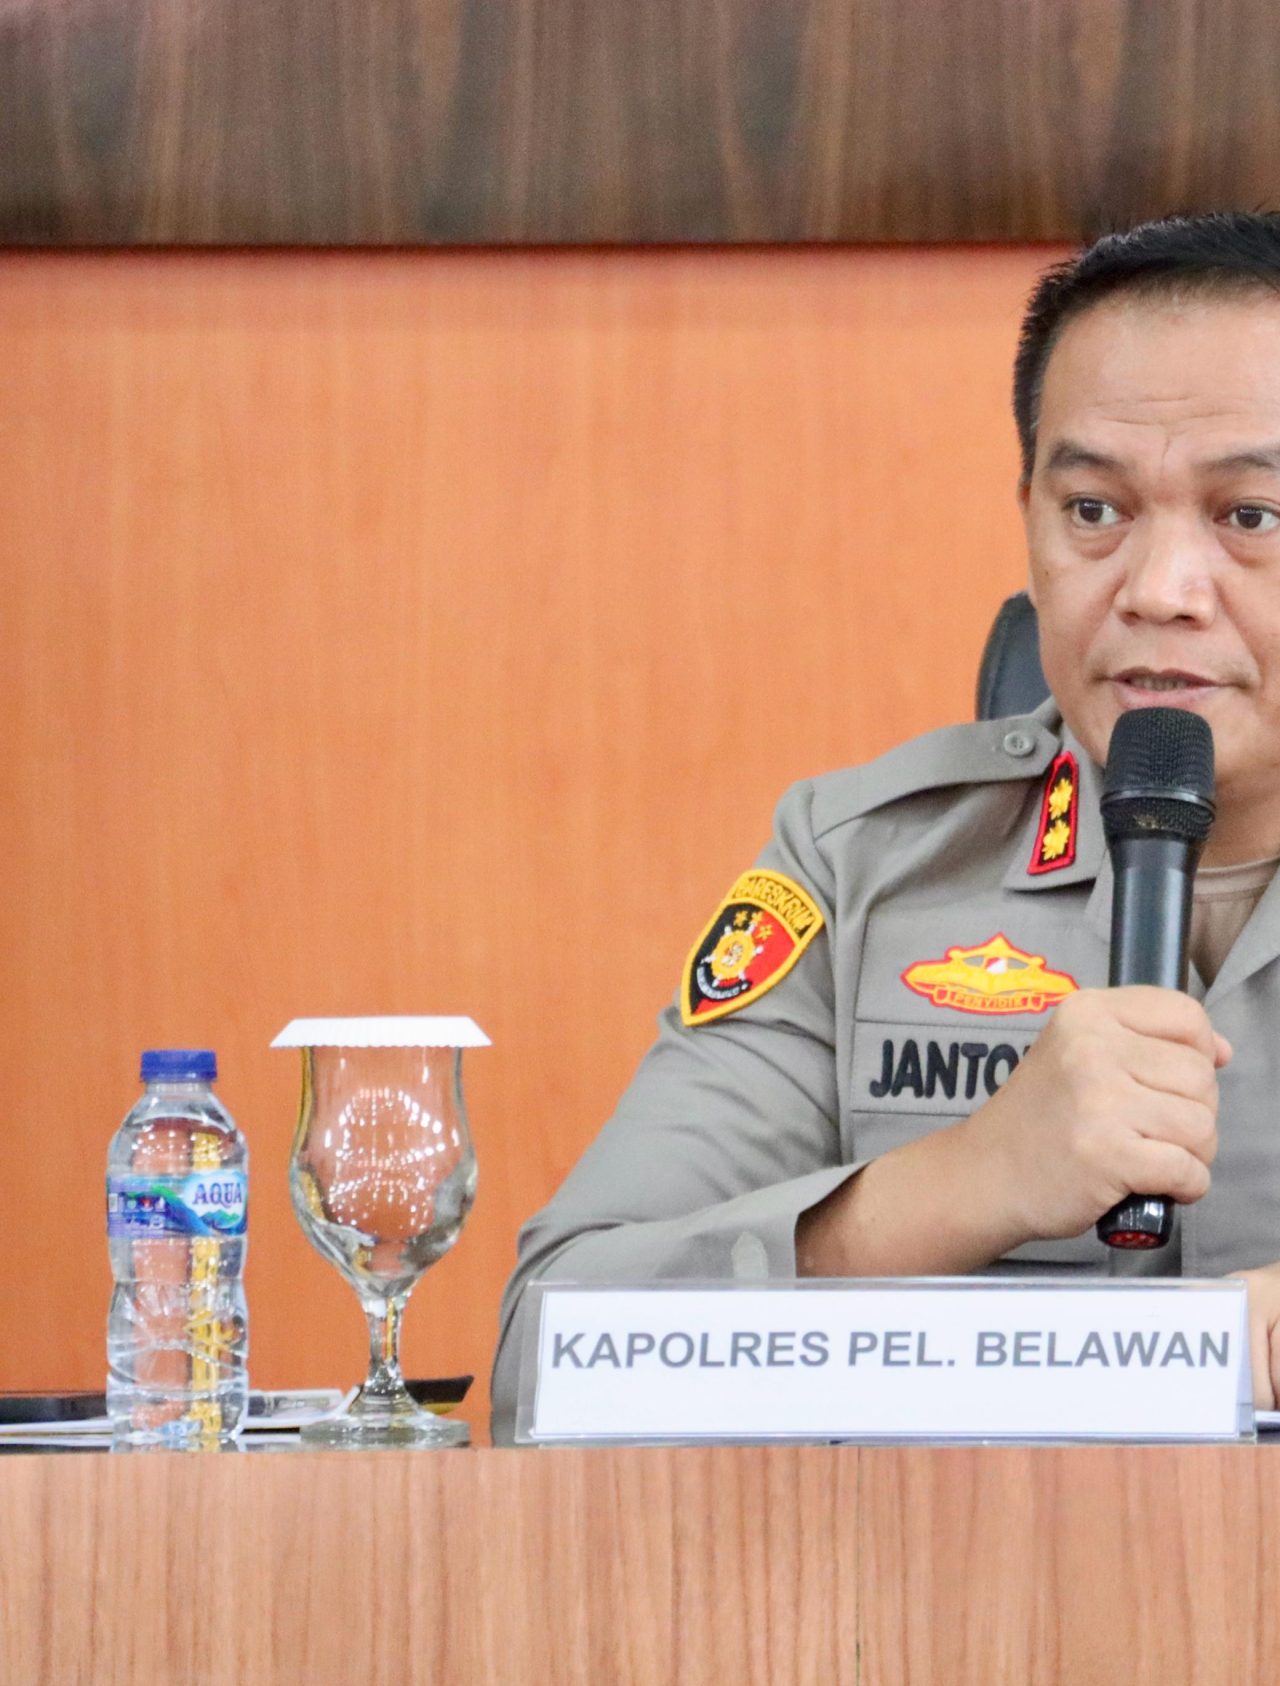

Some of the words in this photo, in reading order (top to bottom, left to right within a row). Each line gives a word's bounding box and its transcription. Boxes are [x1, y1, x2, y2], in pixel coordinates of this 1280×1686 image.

[869, 1039, 1031, 1100] JANTO
[192, 1182, 243, 1208] AQUA
[551, 1331, 830, 1369] KAPOLRES
[847, 1331, 956, 1368] PEL.
[975, 1331, 1231, 1368] BELAWAN
